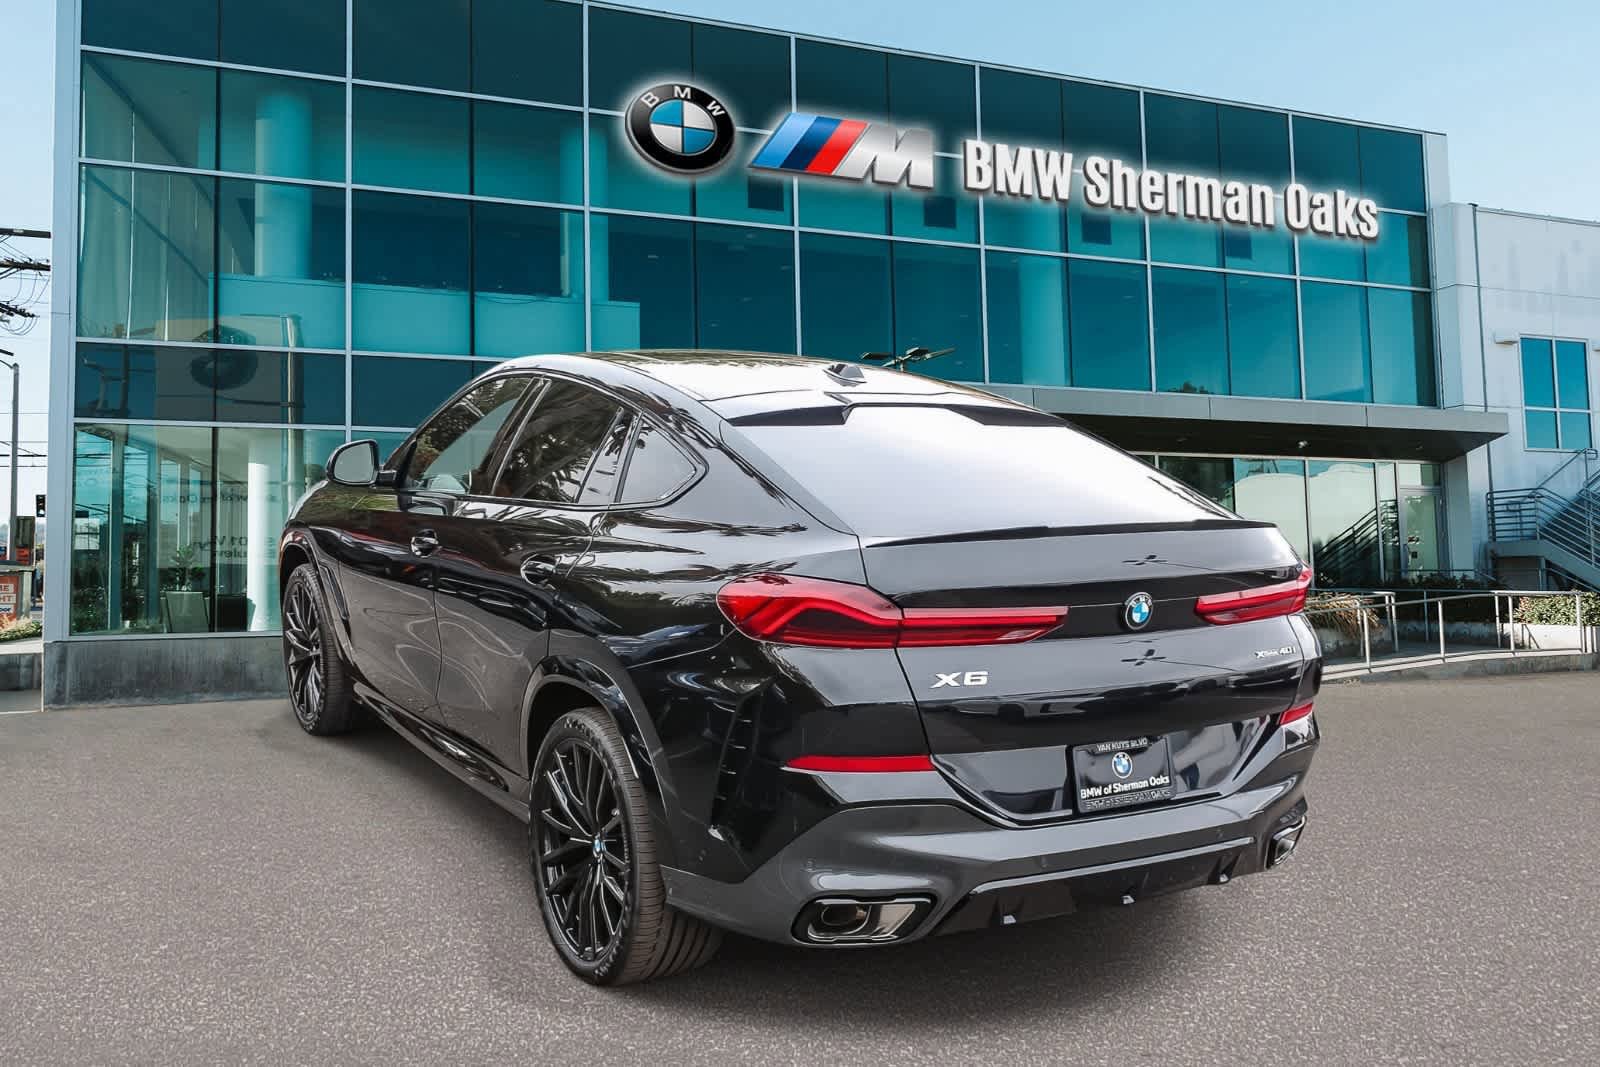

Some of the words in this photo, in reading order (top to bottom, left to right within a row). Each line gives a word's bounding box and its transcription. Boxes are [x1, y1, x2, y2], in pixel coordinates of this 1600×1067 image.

[641, 85, 725, 117] BMW
[963, 139, 1074, 201] BMW
[1082, 155, 1275, 227] Sherman
[1283, 183, 1379, 240] Oaks
[930, 671, 988, 688] X6
[1080, 786, 1102, 799] BMW
[1103, 784, 1112, 794] of
[1112, 780, 1149, 793] Sherman
[1149, 775, 1170, 786] Oaks
